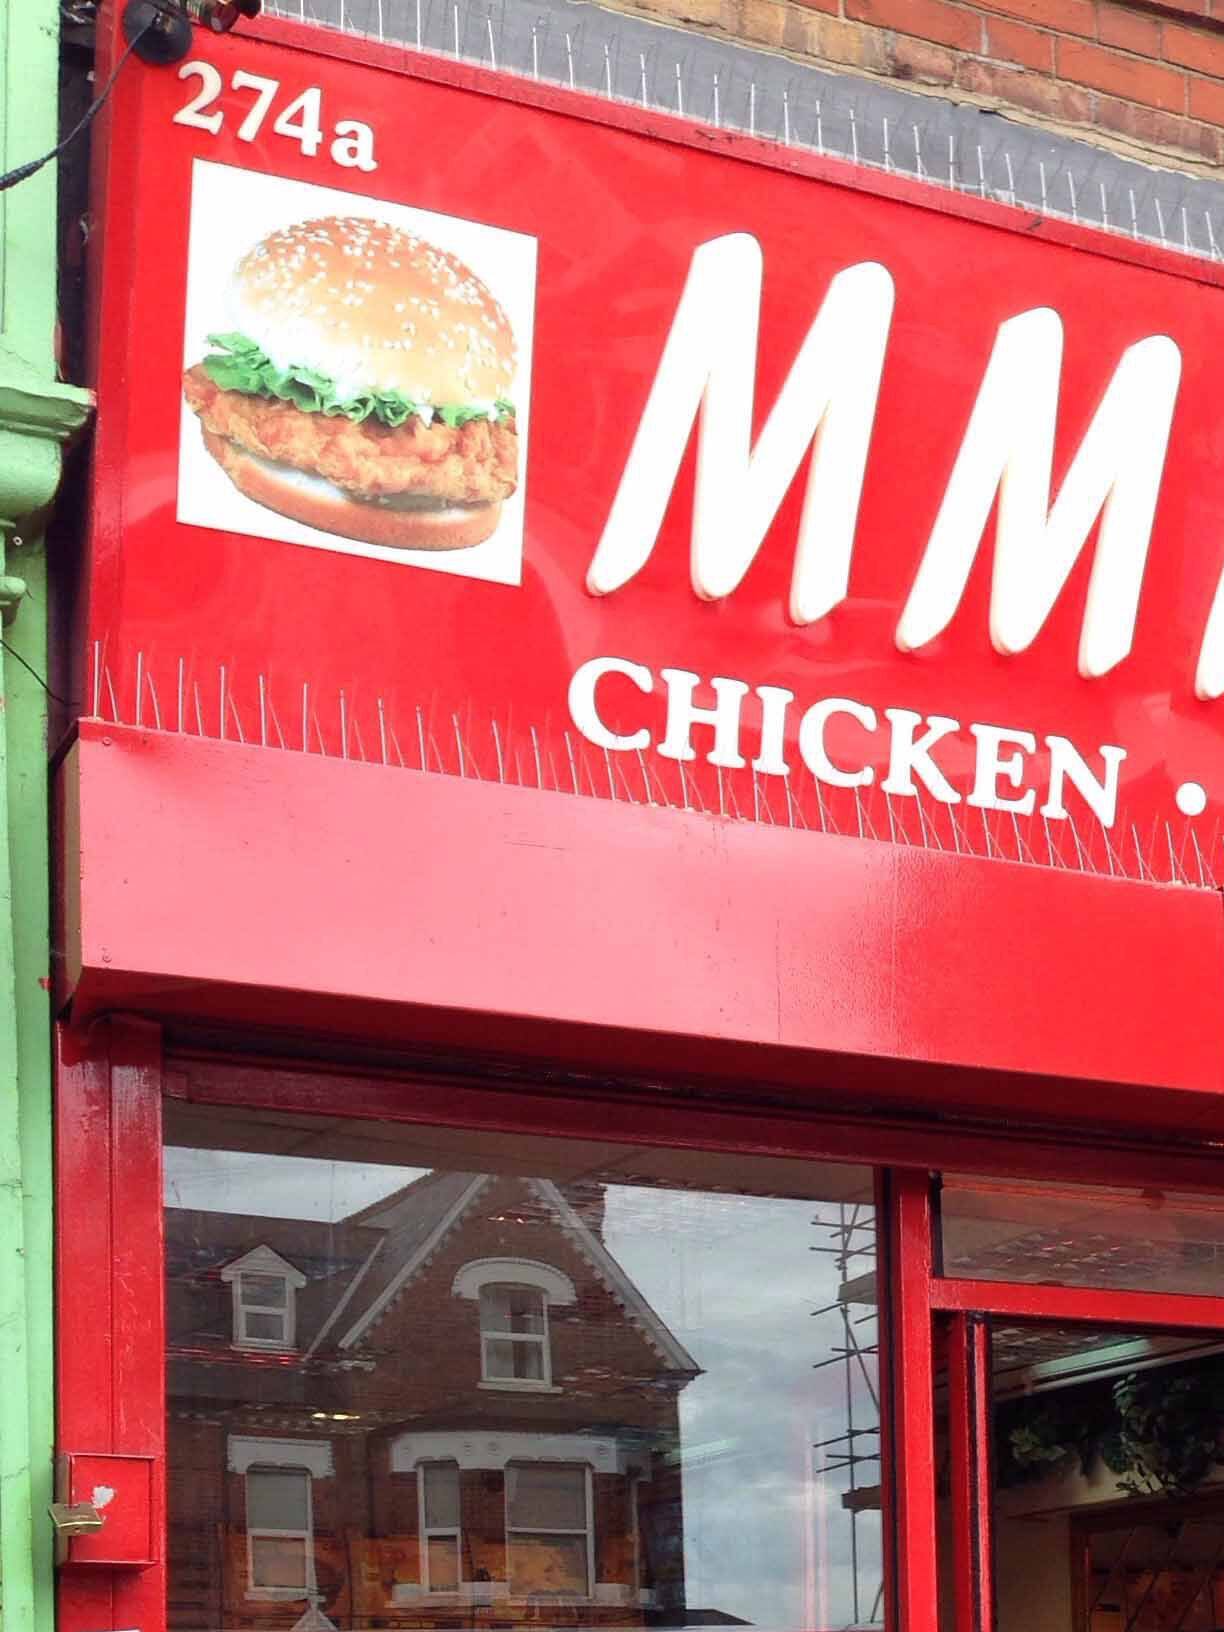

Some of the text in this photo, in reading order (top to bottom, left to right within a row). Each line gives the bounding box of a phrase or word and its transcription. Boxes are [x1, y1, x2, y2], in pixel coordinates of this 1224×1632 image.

[173, 61, 378, 173] 274a
[586, 231, 896, 626] M
[894, 307, 1183, 680] M
[568, 656, 1127, 829] CHICKEN
